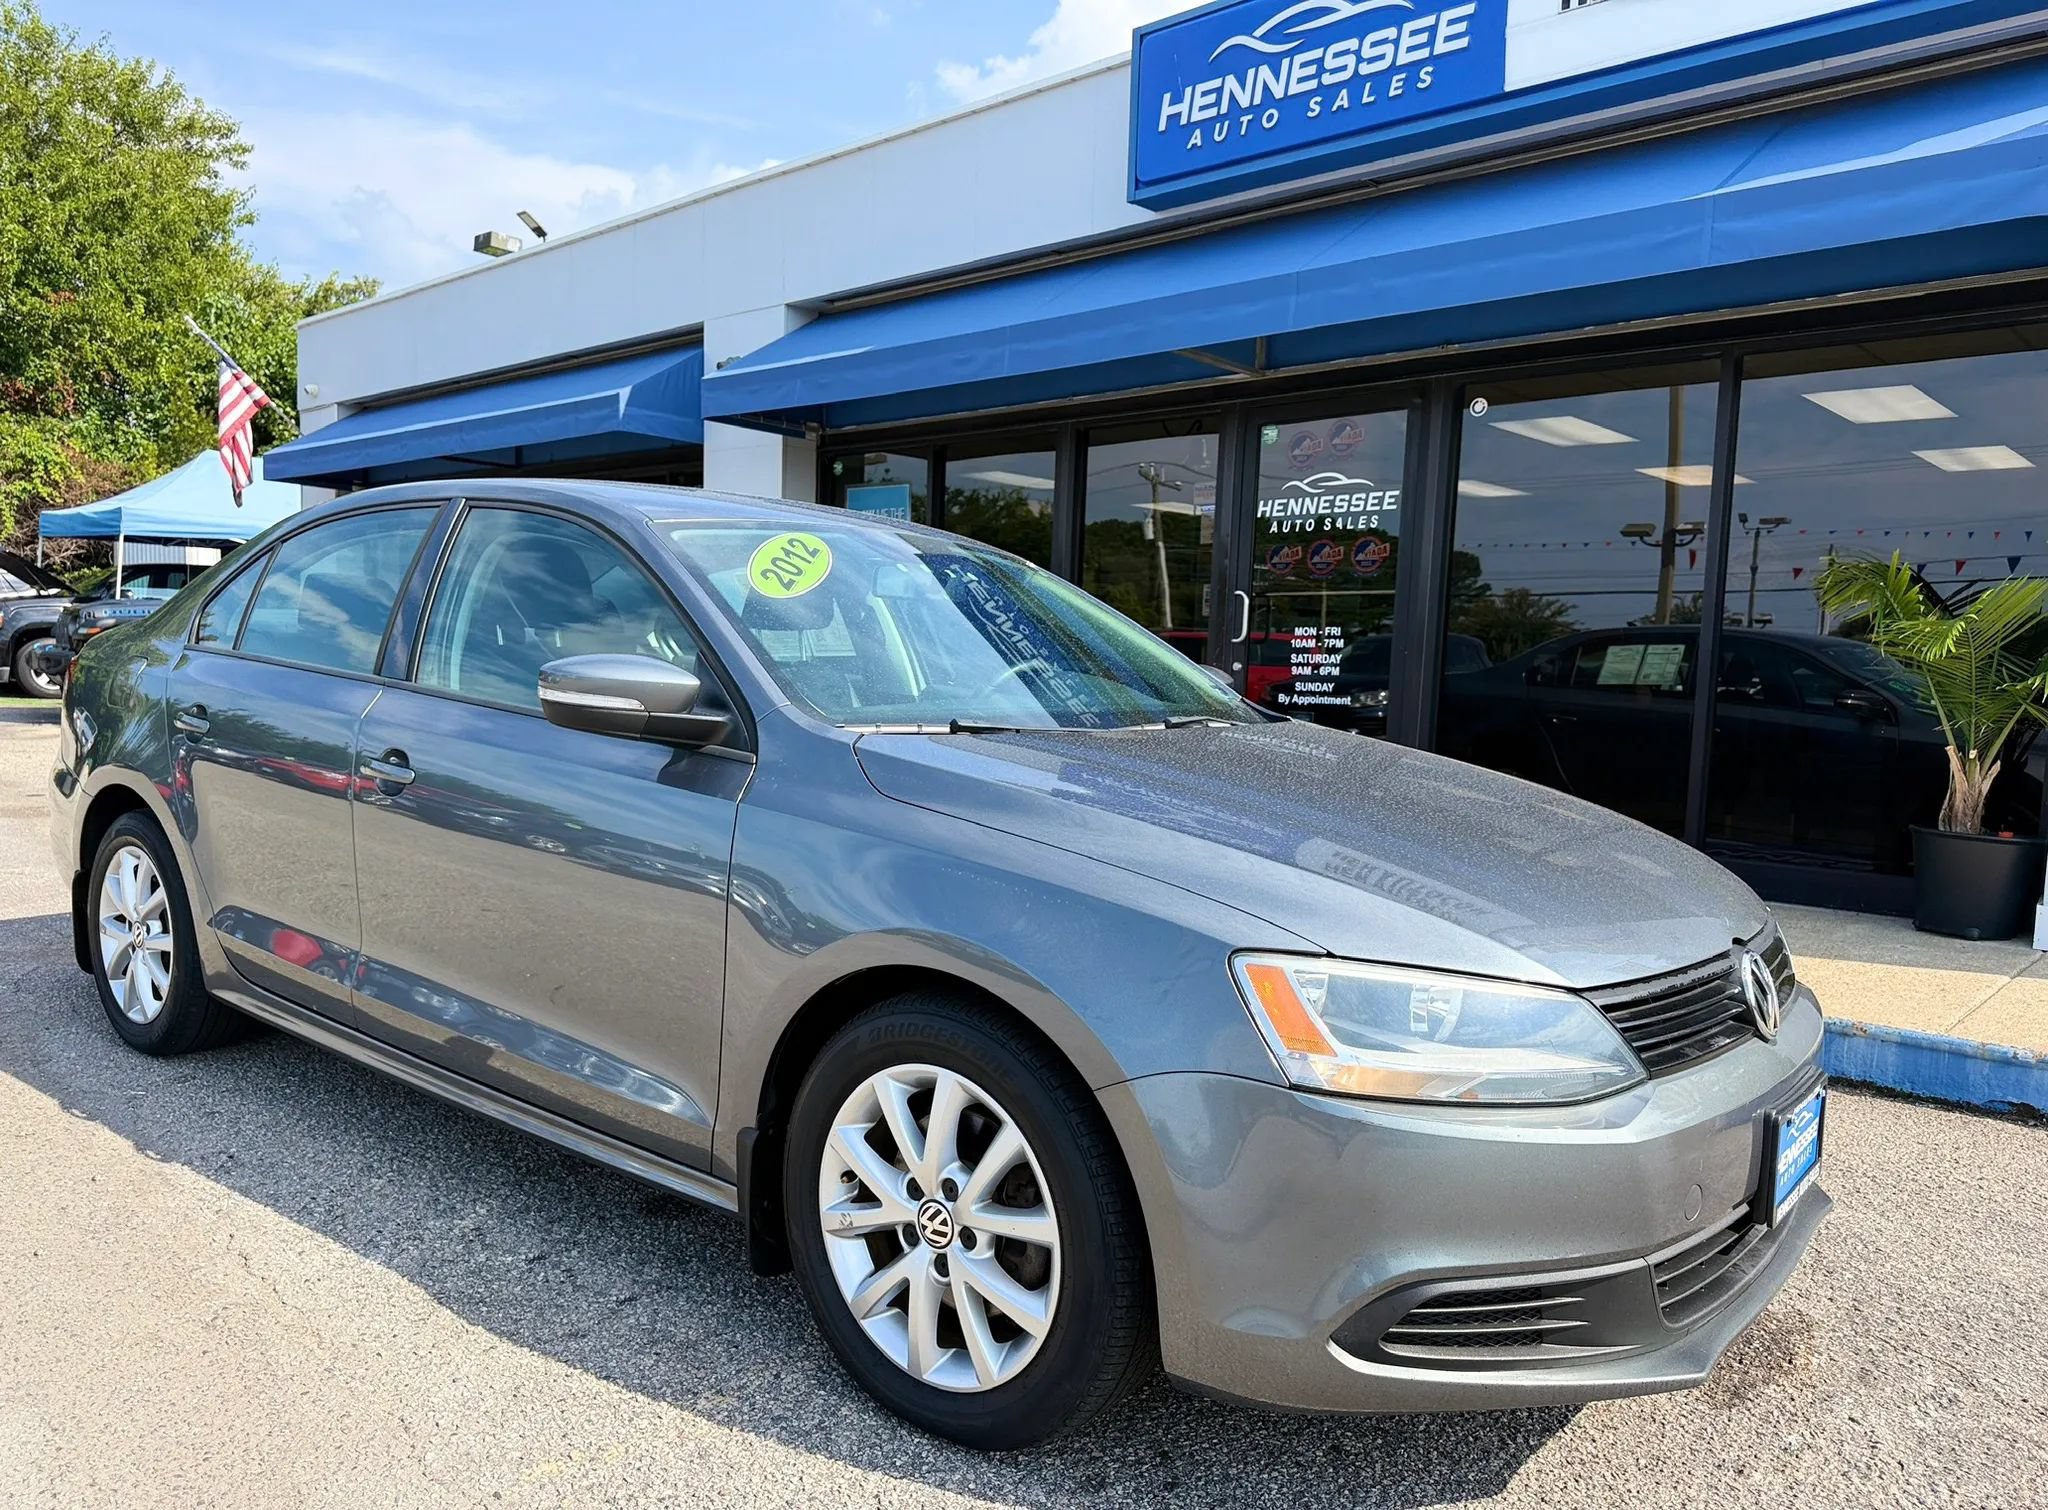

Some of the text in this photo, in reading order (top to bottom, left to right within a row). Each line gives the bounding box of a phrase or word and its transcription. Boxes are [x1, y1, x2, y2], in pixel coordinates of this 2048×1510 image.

[1157, 2, 1477, 131] HENNESSEE
[1186, 66, 1435, 149] AUTO SALES
[1257, 490, 1400, 518] HENNESSEE
[1269, 515, 1379, 533] AUTO SALES
[760, 538, 820, 591] 2012
[1294, 627, 1317, 636] MON
[1325, 627, 1341, 636] FRI
[1290, 639, 1316, 648] 10AM
[1324, 639, 1344, 648] 7PM
[1290, 654, 1342, 663] SATURDAY
[1291, 666, 1312, 675] 9AM
[1319, 666, 1340, 675] 6PM
[1295, 682, 1335, 692] SUNDAY
[1278, 693, 1351, 705] By Appointment
